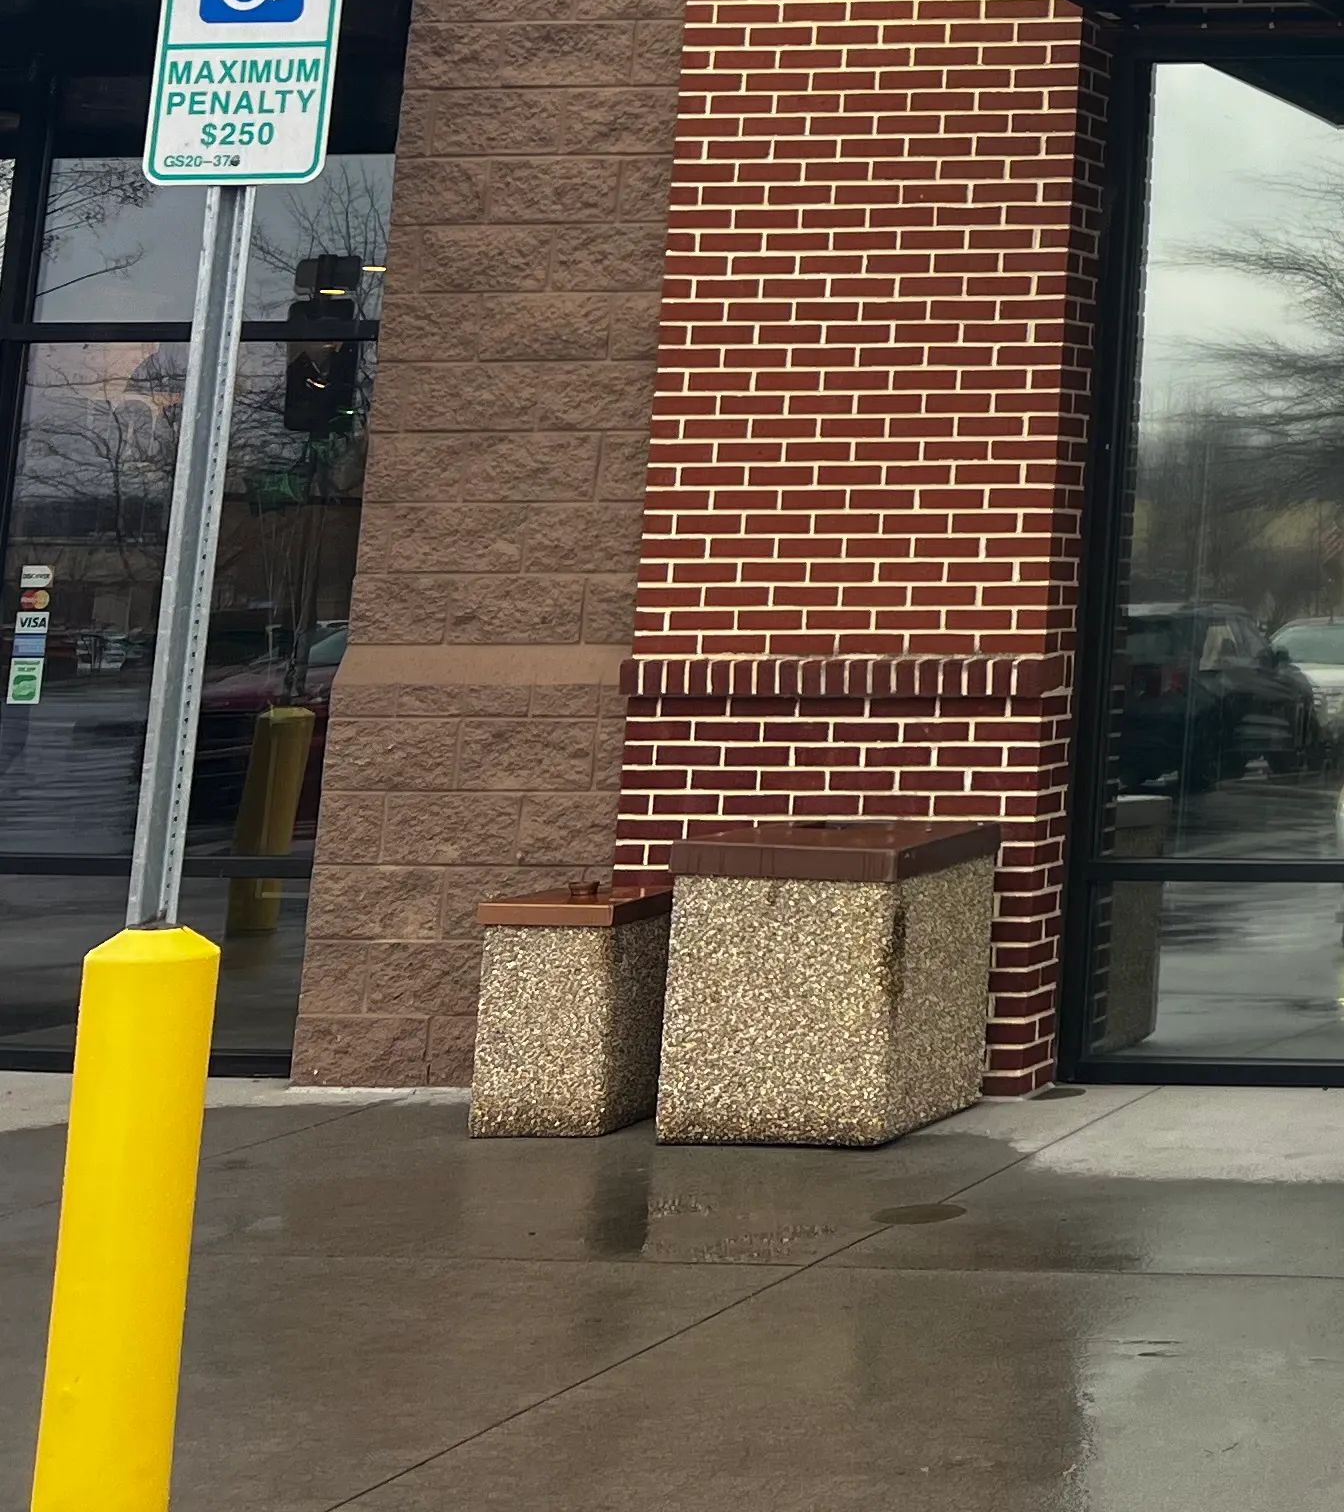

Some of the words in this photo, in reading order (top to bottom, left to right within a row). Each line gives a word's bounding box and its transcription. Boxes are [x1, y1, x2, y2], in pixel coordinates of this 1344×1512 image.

[167, 58, 321, 85] MAXIMUM
[166, 88, 317, 115] PENALTY
[200, 121, 275, 149] $250
[19, 617, 47, 628] VISA
